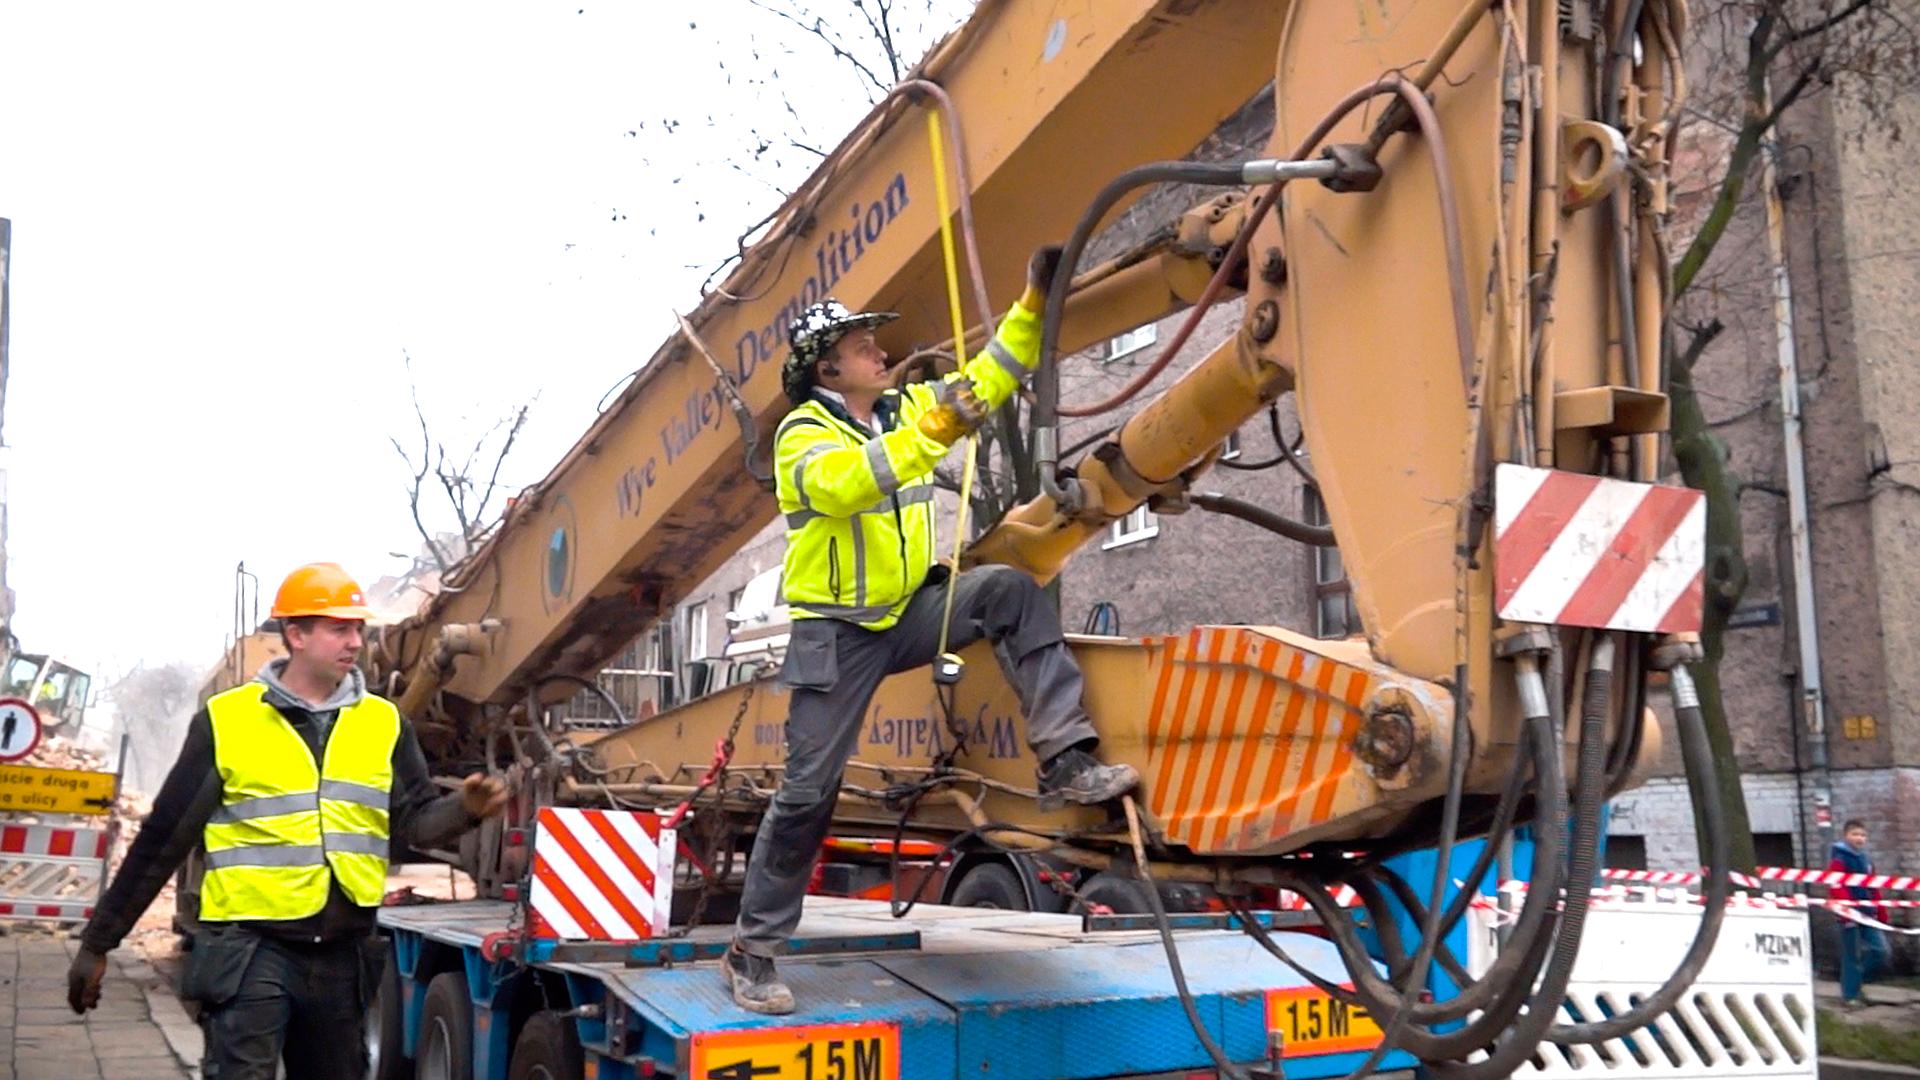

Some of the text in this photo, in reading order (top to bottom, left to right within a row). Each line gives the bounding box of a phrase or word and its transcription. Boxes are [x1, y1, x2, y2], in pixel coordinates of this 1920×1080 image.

[616, 172, 910, 519] Wye Valley Demolition
[868, 704, 943, 757] Valley
